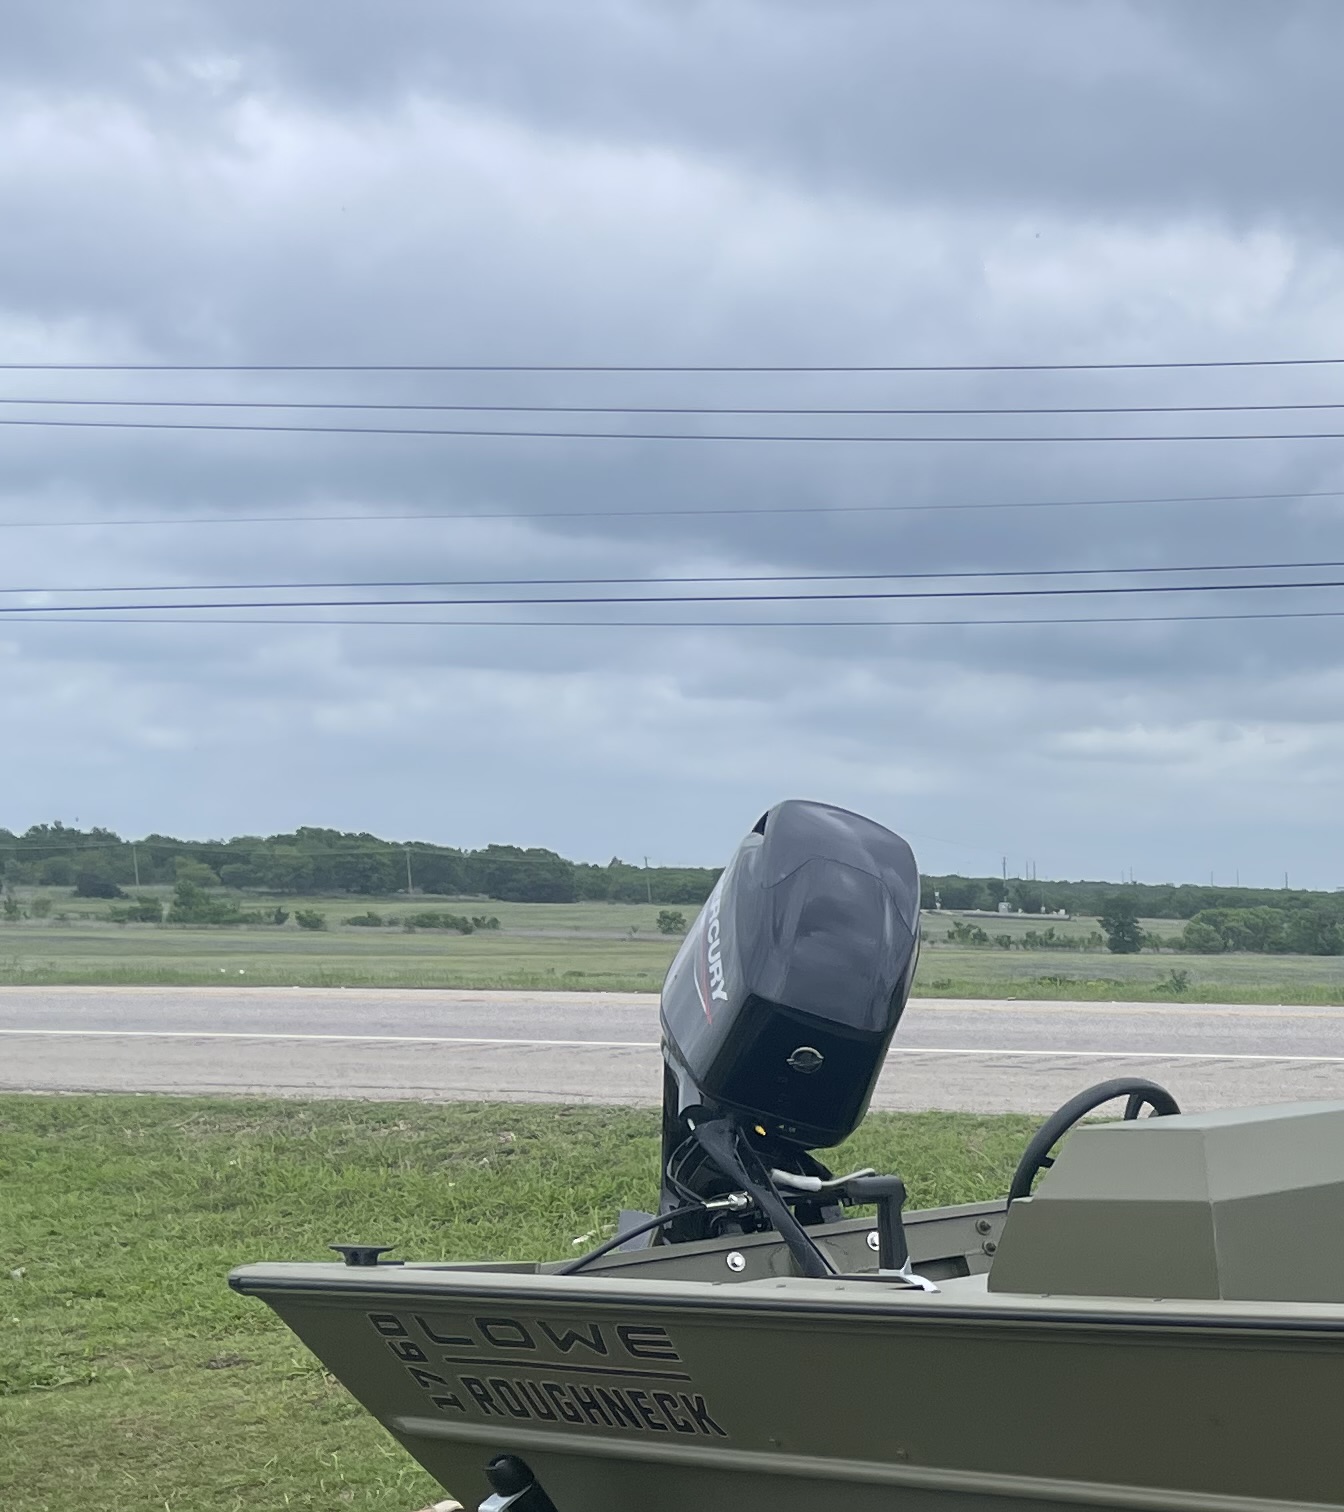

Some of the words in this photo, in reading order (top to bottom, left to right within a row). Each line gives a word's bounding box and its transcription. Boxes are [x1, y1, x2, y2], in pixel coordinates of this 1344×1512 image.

[708, 884, 728, 1001] RCURY
[413, 1314, 682, 1362] LOWE
[459, 1375, 729, 1438] ROUGHNECK
